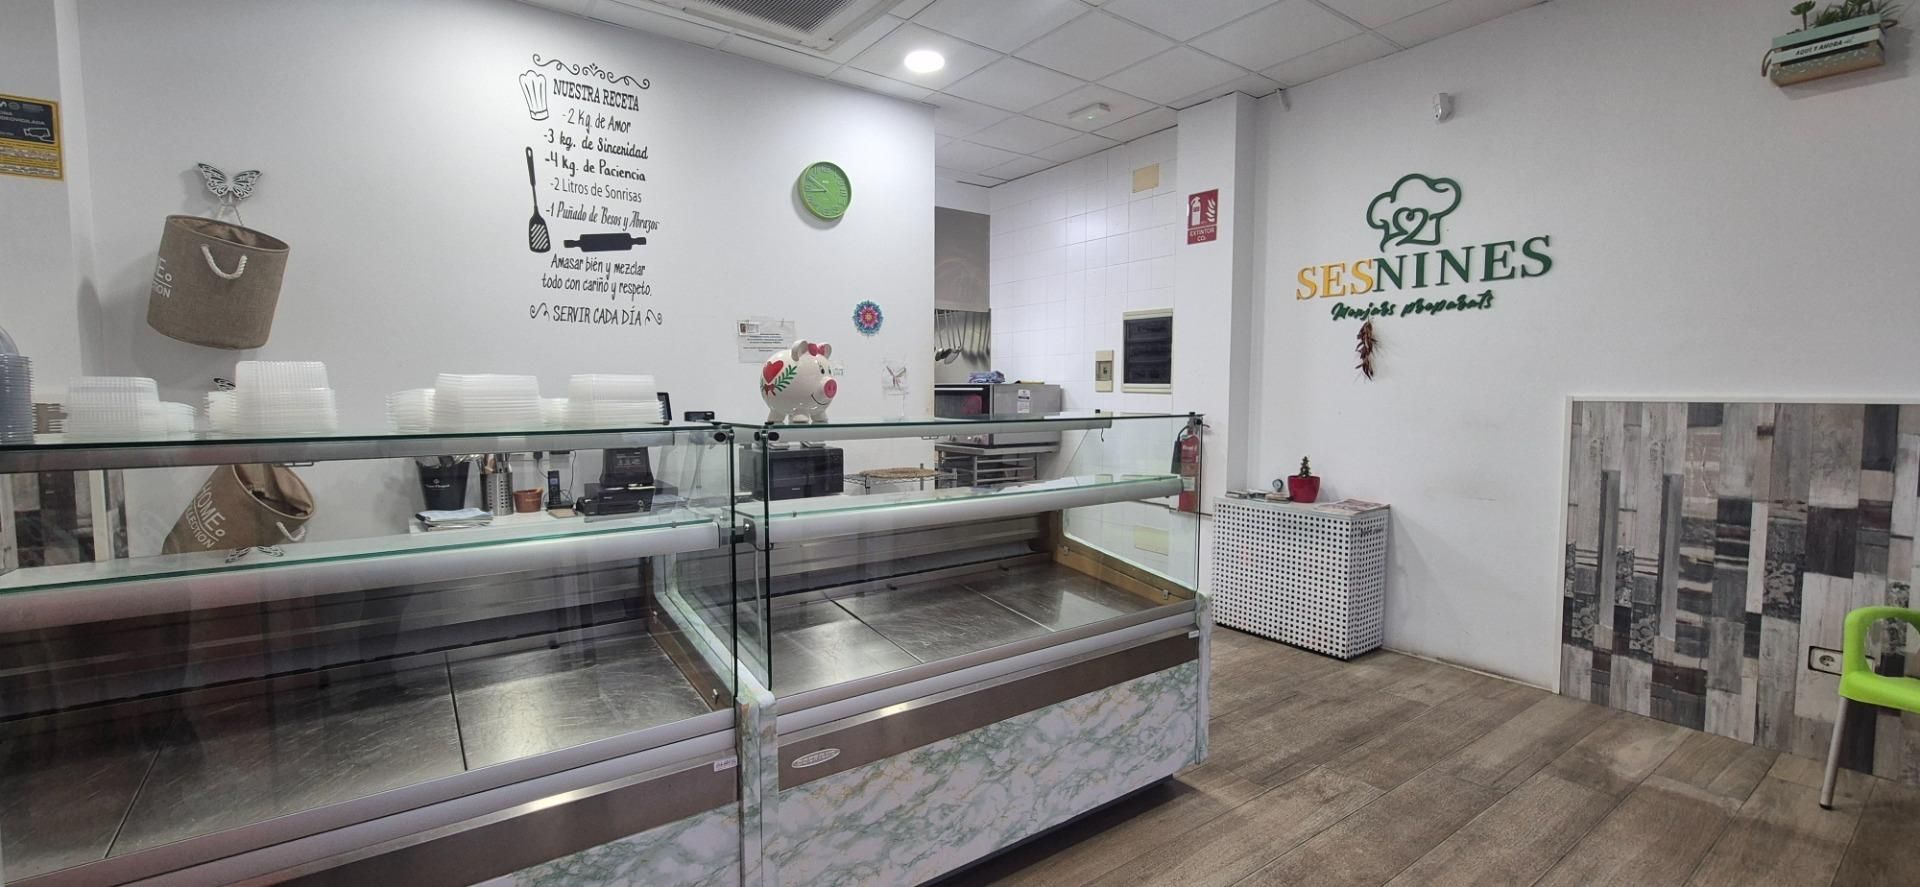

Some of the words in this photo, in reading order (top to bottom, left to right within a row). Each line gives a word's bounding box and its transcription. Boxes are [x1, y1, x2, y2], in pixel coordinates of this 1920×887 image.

[553, 78, 600, 104] NUESTRA
[602, 88, 639, 112] RECETA
[595, 113, 606, 130] de
[608, 115, 632, 134] Amor
[543, 128, 554, 144] -3
[560, 131, 577, 151] kg.
[582, 134, 593, 151] de
[597, 137, 649, 160] Sinceridad
[545, 151, 558, 168] -4
[583, 158, 595, 174] de
[599, 159, 646, 181] Paciencia
[562, 178, 589, 195] Litros
[591, 183, 603, 198] de
[605, 184, 642, 203] Sonrisas
[556, 200, 587, 221] Puñado
[588, 205, 598, 223] de
[600, 206, 622, 226] Besos
[622, 216, 629, 231] y
[629, 210, 660, 234] Abrazos
[551, 253, 584, 271] Amasar
[605, 262, 611, 280] y
[614, 261, 646, 276] mezclar
[541, 273, 563, 289] todo
[564, 278, 581, 291] con
[582, 277, 609, 293] cariño
[611, 281, 617, 301] y
[619, 281, 652, 302] respeto.
[553, 304, 591, 324] SERVIR
[593, 307, 619, 326] CADA
[621, 305, 642, 326] DÍA
